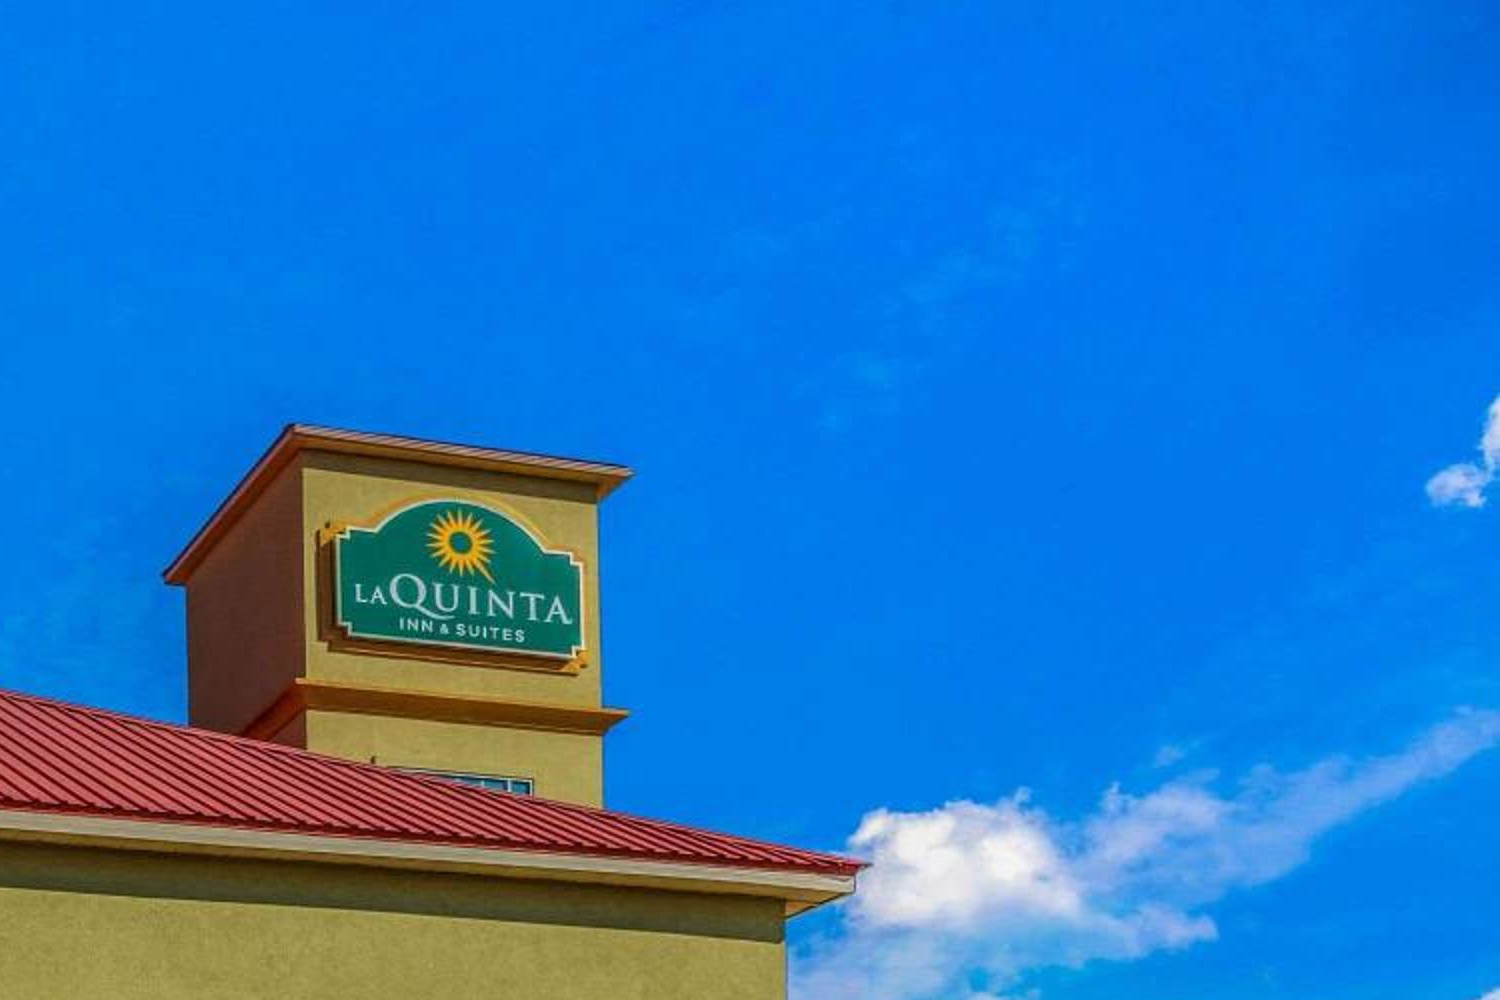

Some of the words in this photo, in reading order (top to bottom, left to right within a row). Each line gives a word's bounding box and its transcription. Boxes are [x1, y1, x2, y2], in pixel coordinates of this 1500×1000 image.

[400, 618, 433, 633] INN
[439, 623, 449, 635] &
[456, 623, 525, 643] SUITES
